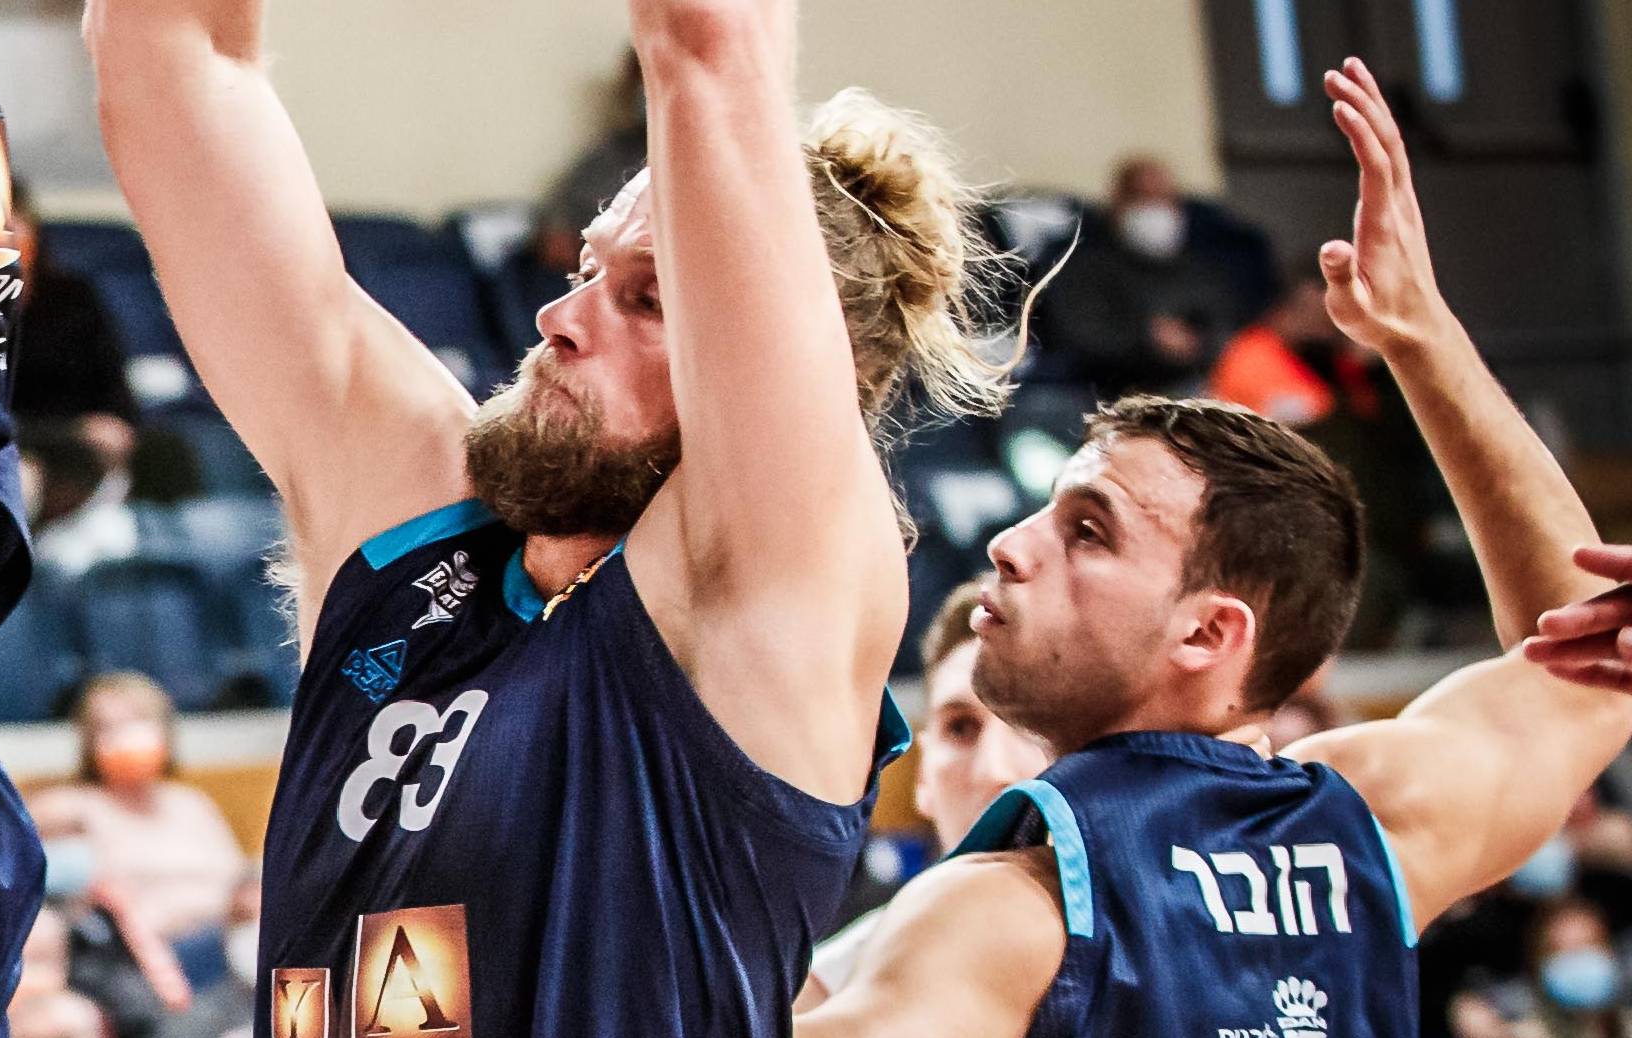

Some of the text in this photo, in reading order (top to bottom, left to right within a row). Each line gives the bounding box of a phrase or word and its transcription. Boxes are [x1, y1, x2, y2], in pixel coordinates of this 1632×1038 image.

[336, 689, 489, 843] 83
[1171, 842, 1353, 937] הובר
[366, 924, 460, 1036] A
